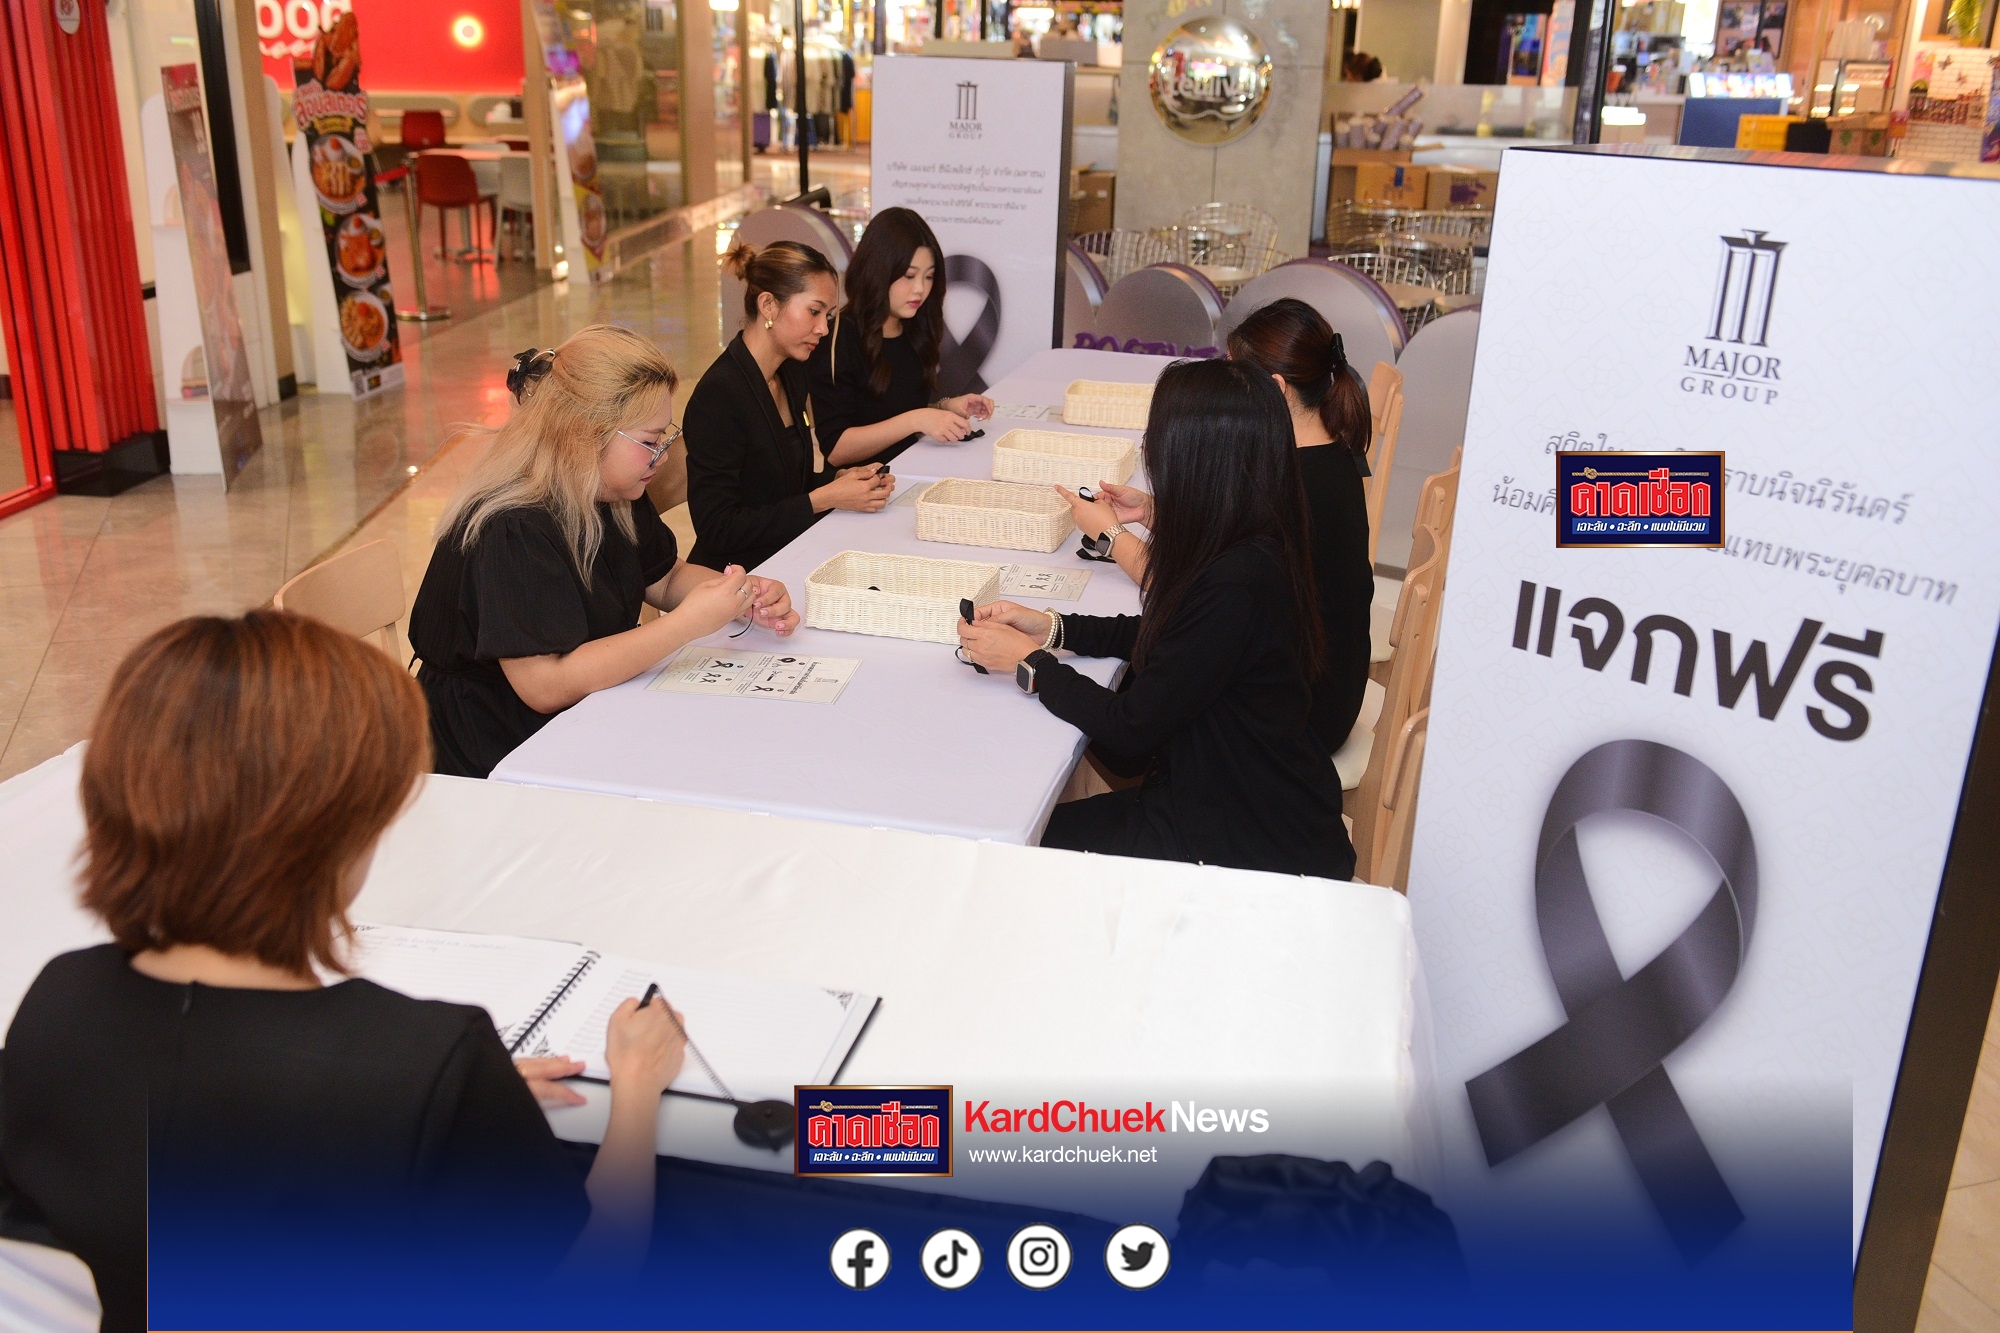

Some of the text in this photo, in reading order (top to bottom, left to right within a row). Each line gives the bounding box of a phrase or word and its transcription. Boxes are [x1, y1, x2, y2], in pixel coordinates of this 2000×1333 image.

[949, 121, 983, 132] MAJOR
[949, 132, 983, 140] GROUP
[1684, 344, 1782, 380] MAJOR
[1681, 376, 1779, 406] GROUP
[1512, 579, 1885, 741] แจกฟรี
